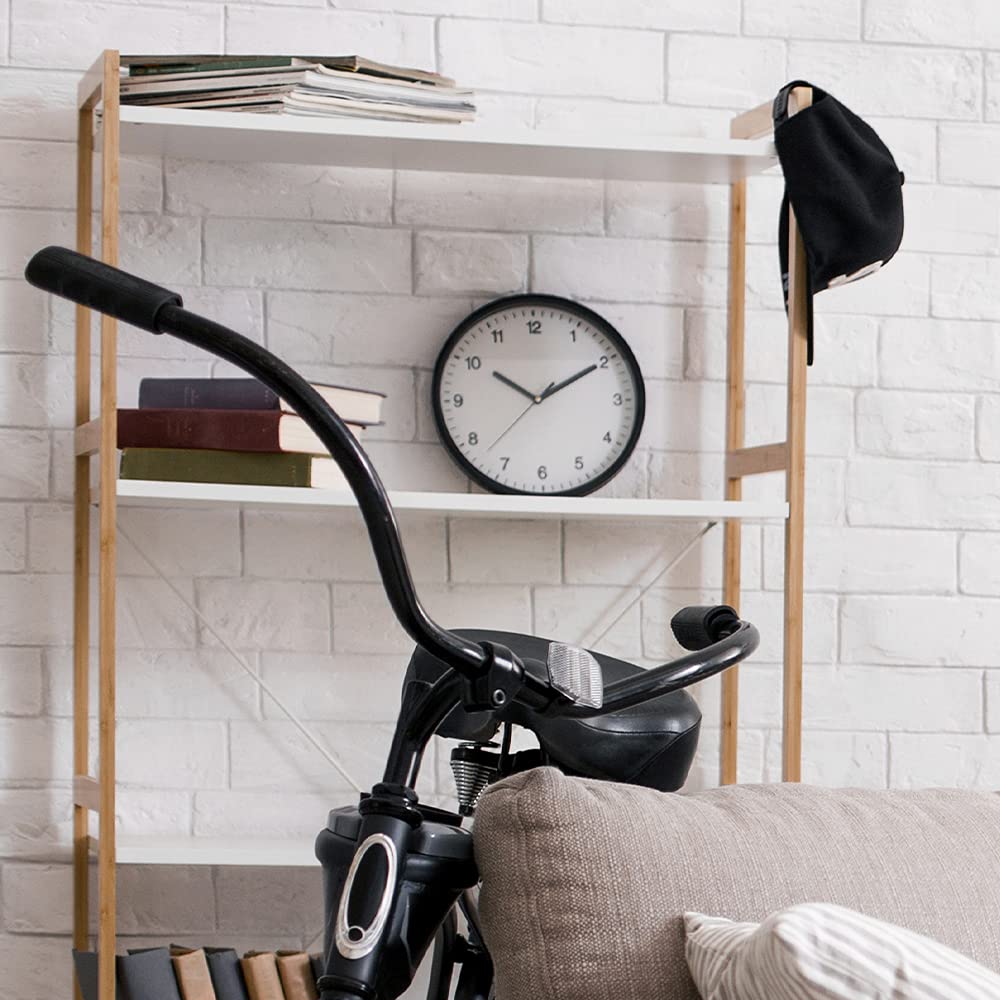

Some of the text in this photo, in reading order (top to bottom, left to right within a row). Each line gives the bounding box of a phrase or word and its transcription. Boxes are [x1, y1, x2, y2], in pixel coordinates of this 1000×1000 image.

[527, 320, 542, 334] 12
[491, 330, 504, 343] 11
[569, 330, 577, 343] 1
[465, 356, 482, 370] 10
[599, 355, 609, 369] 2
[453, 393, 463, 407] 9
[612, 393, 622, 406] 3
[468, 432, 478, 445] 8
[602, 432, 612, 444] 4
[500, 457, 510, 470] 7
[575, 456, 584, 469] 5
[537, 465, 547, 479] 6
